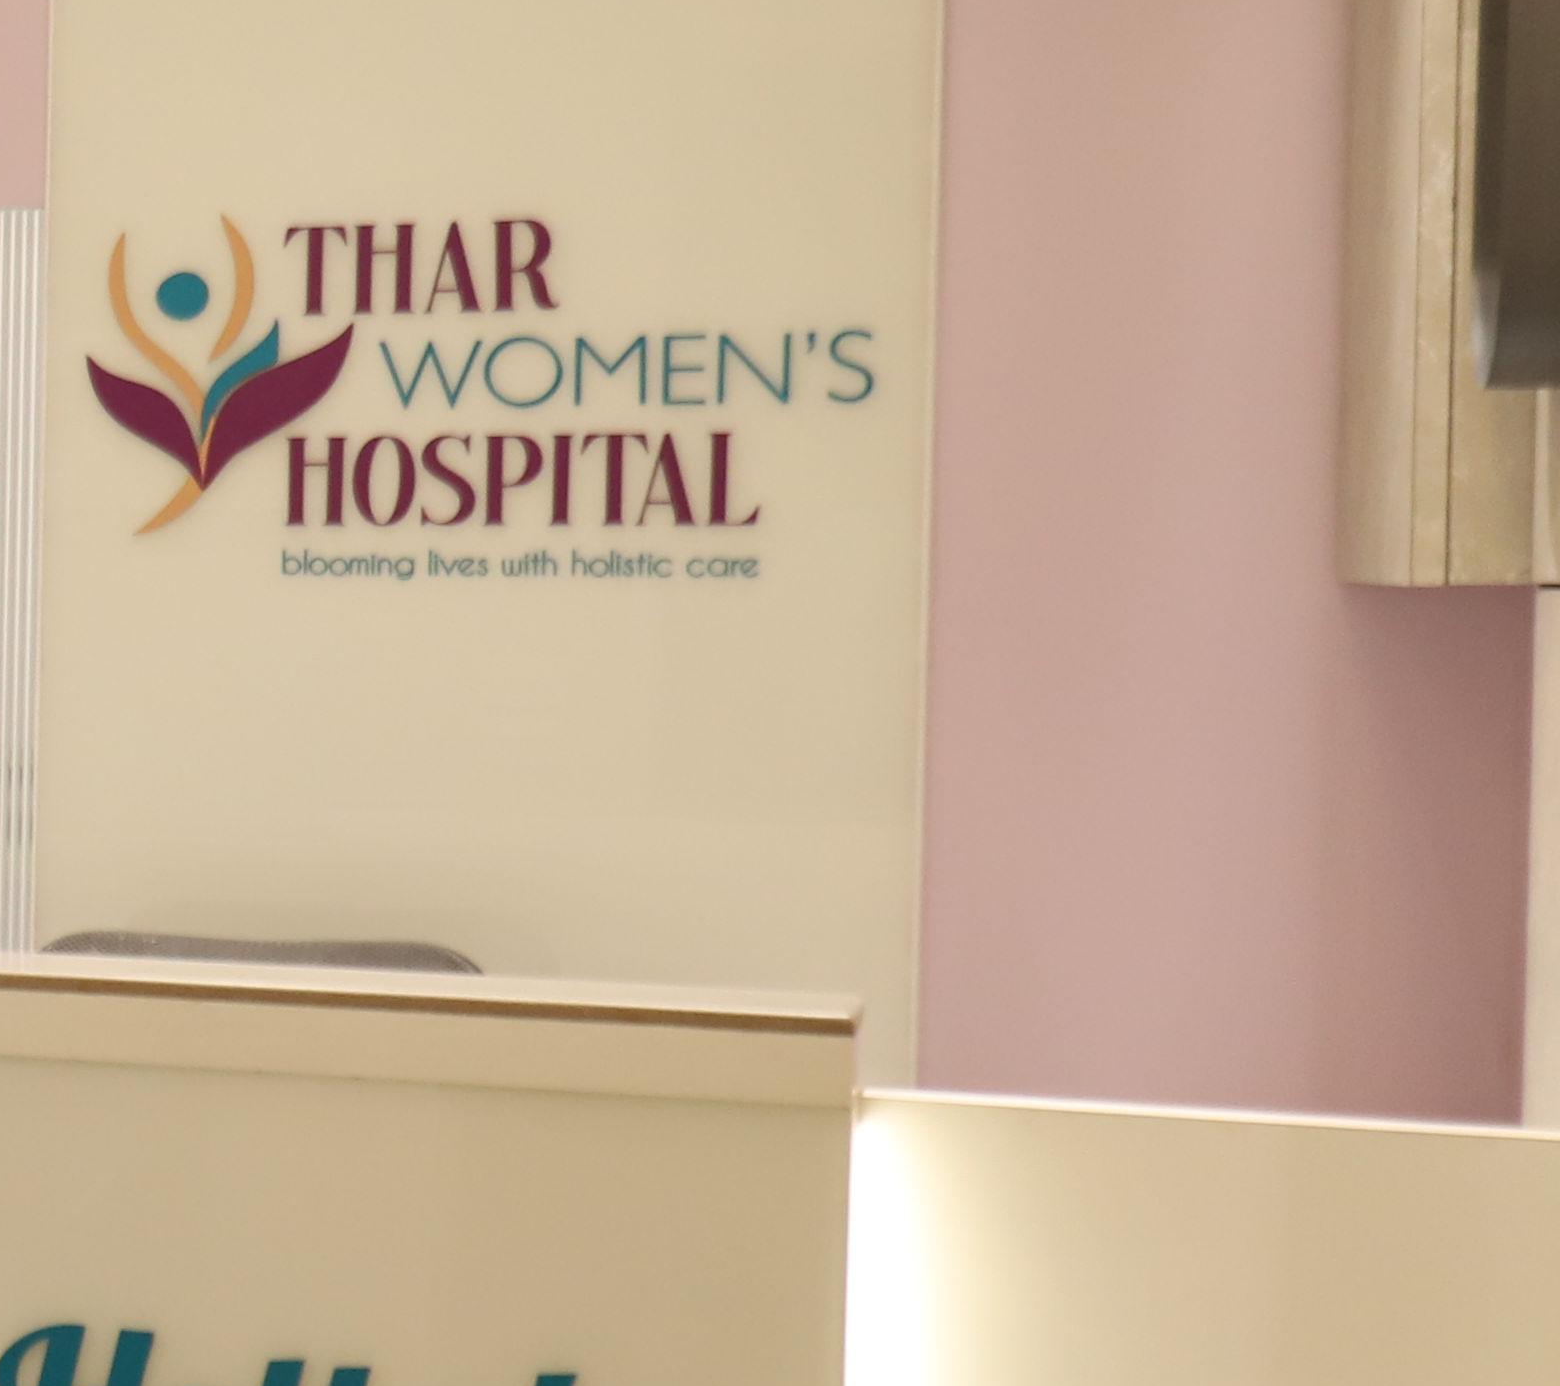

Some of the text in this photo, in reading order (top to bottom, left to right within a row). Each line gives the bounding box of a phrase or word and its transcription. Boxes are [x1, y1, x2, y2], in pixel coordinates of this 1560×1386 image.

[284, 217, 559, 317] THAR
[379, 326, 876, 410] WOMEN'S
[285, 429, 761, 527] HOSPITAL
[282, 549, 759, 580] blooming lives with holistic care
